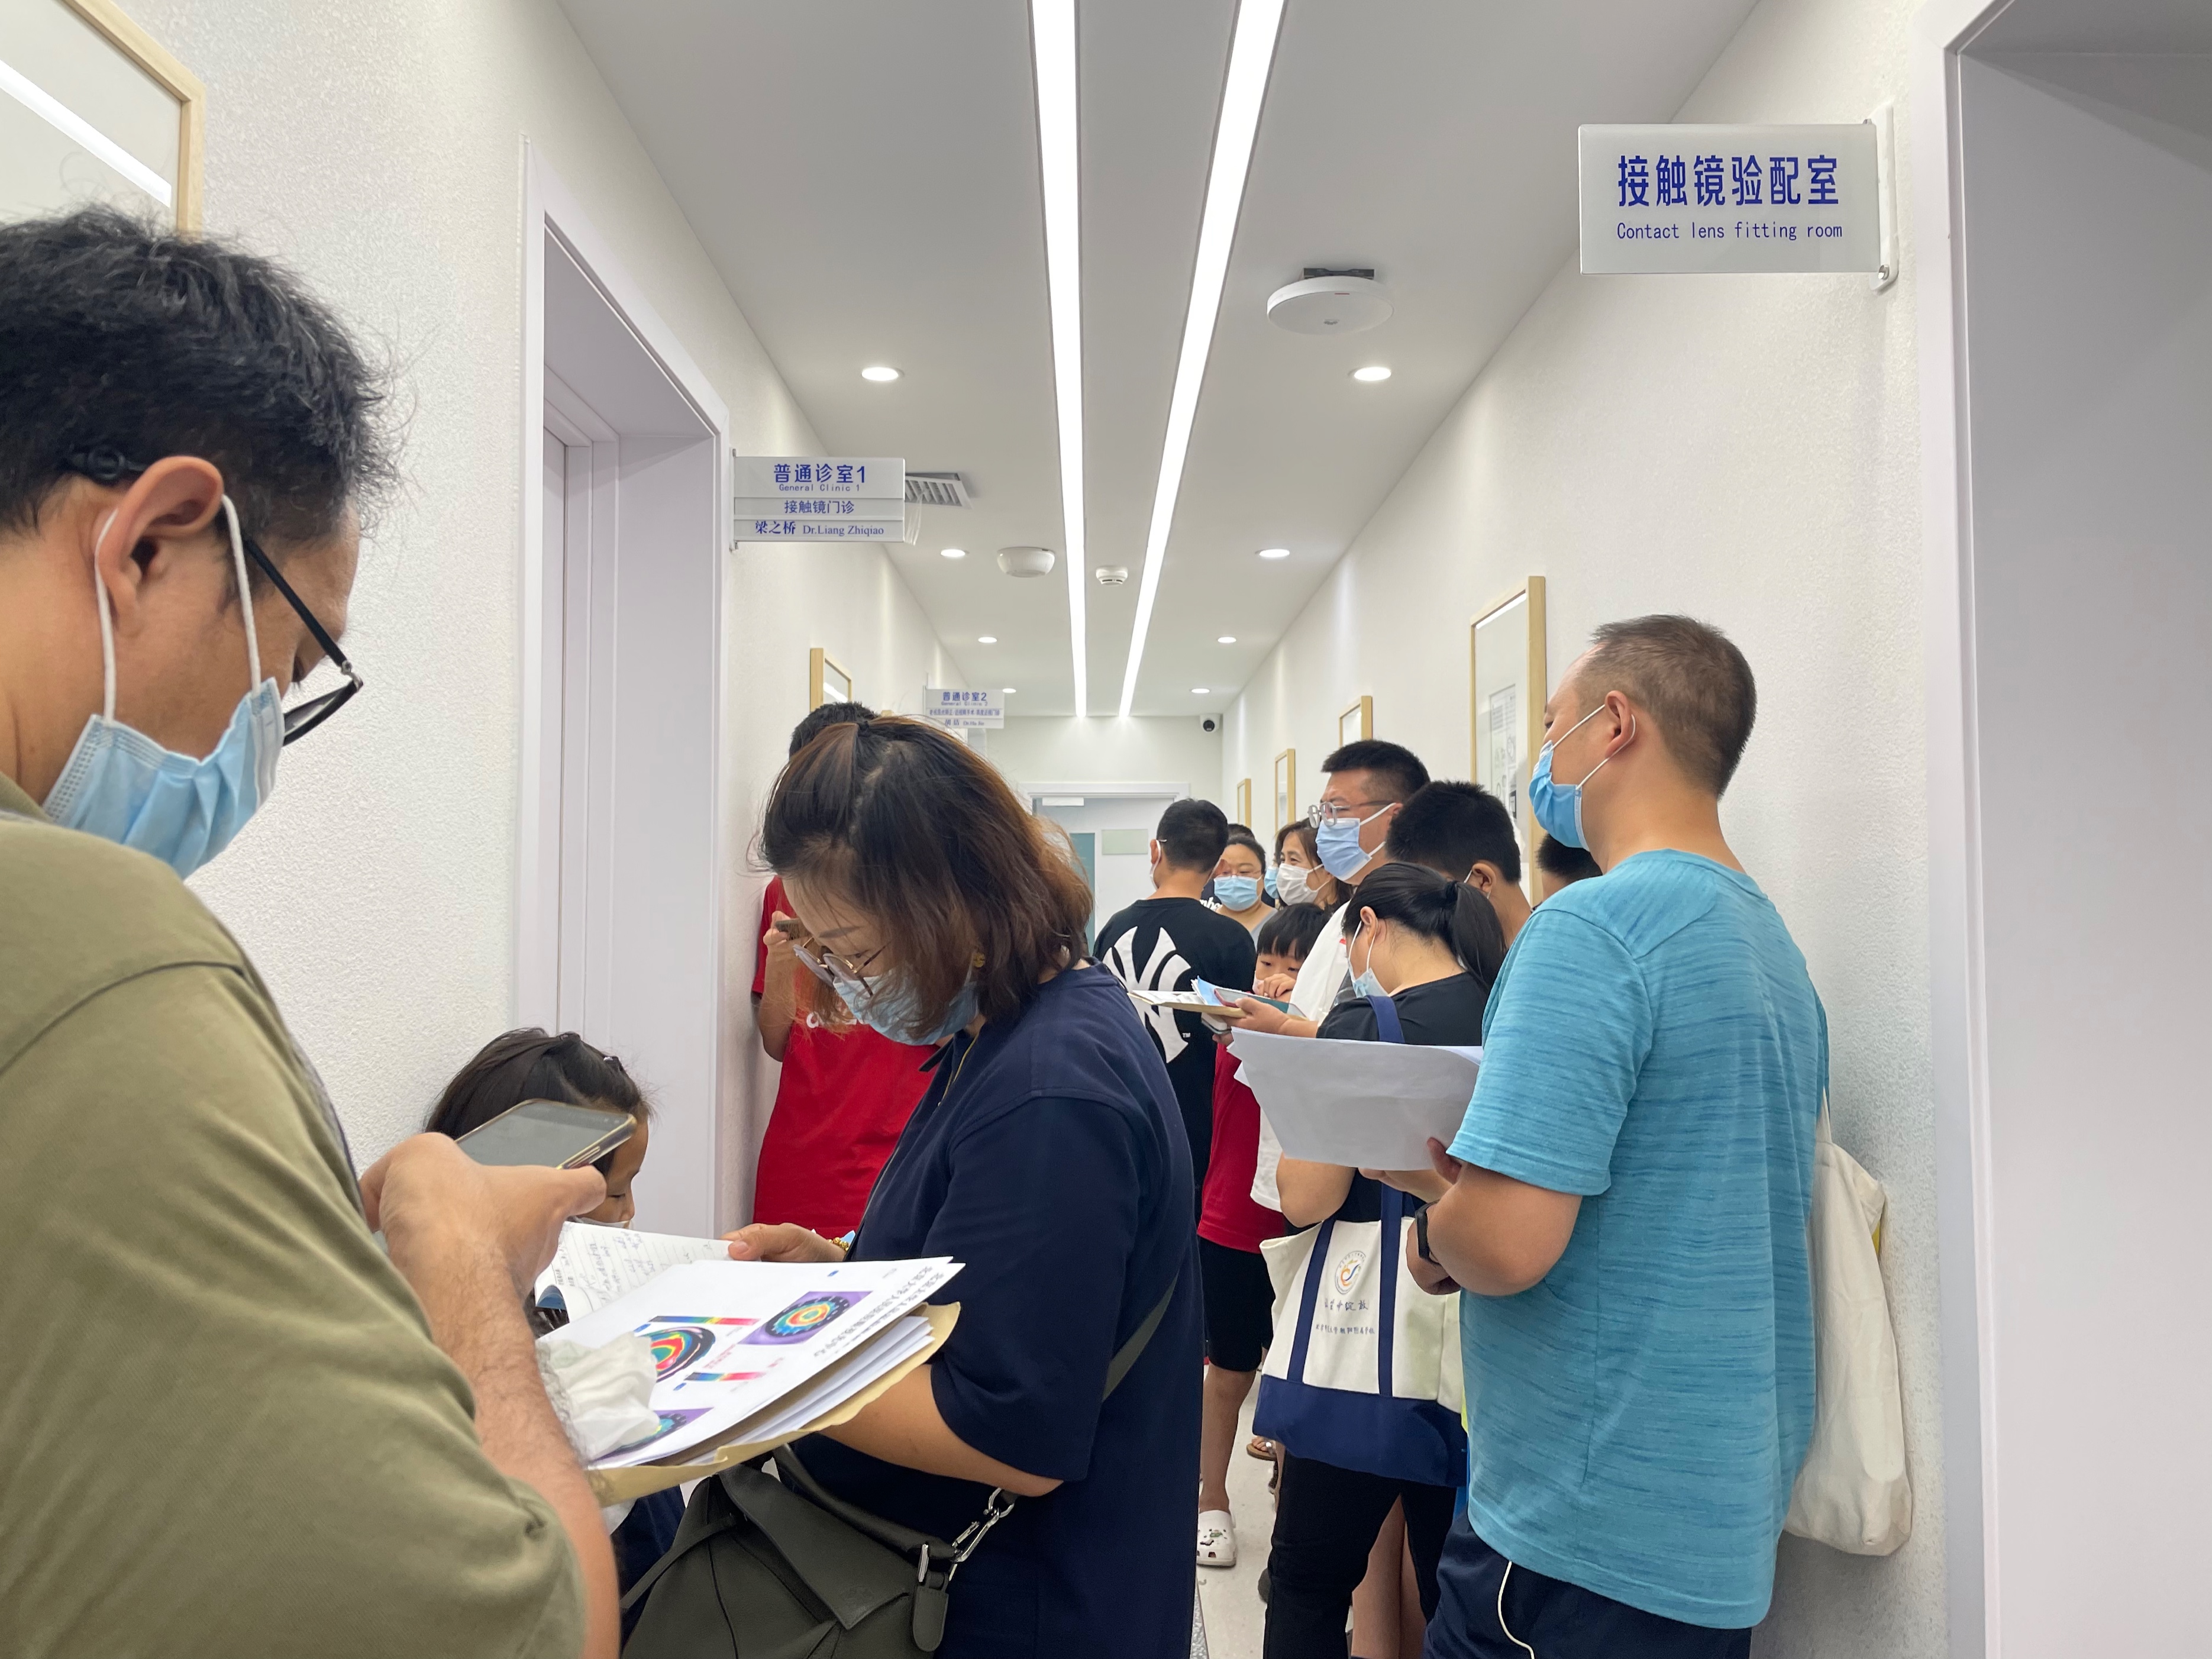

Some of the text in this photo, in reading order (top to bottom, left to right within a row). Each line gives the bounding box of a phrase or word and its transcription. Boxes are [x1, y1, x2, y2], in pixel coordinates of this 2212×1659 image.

[1617, 154, 1839, 207] 接触镜验配室
[1617, 221, 1843, 241] Contact lens fitting room
[773, 463, 866, 484] 普通诊室1
[779, 483, 860, 492] General Clinic 1
[784, 500, 854, 514] 接触镜门诊
[755, 520, 884, 537] 梁之桥 Dr.Liang Zhiqiao
[942, 692, 987, 701] 普通诊室2
